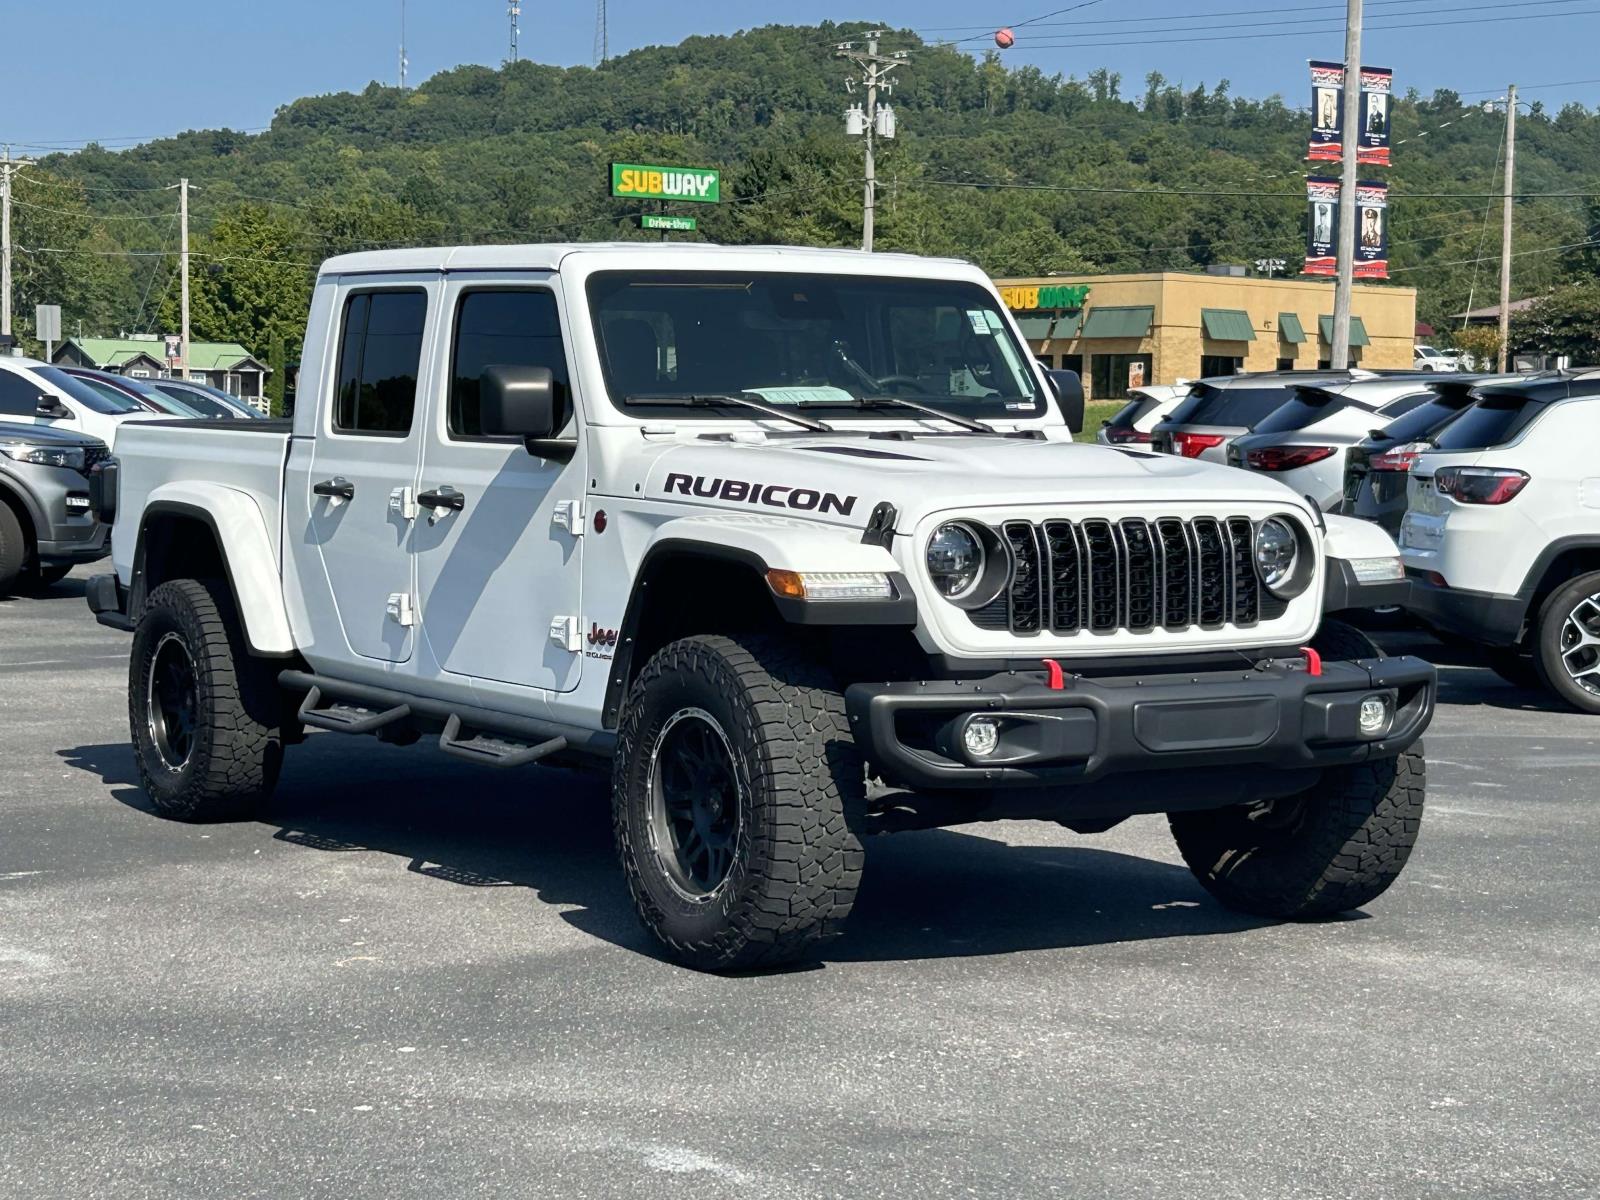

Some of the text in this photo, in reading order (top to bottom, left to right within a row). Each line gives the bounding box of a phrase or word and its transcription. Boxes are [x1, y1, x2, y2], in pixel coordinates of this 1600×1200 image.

[617, 170, 715, 197] SUBWAY
[1001, 286, 1088, 309] SUBWAY
[663, 472, 858, 517] RUBICON
